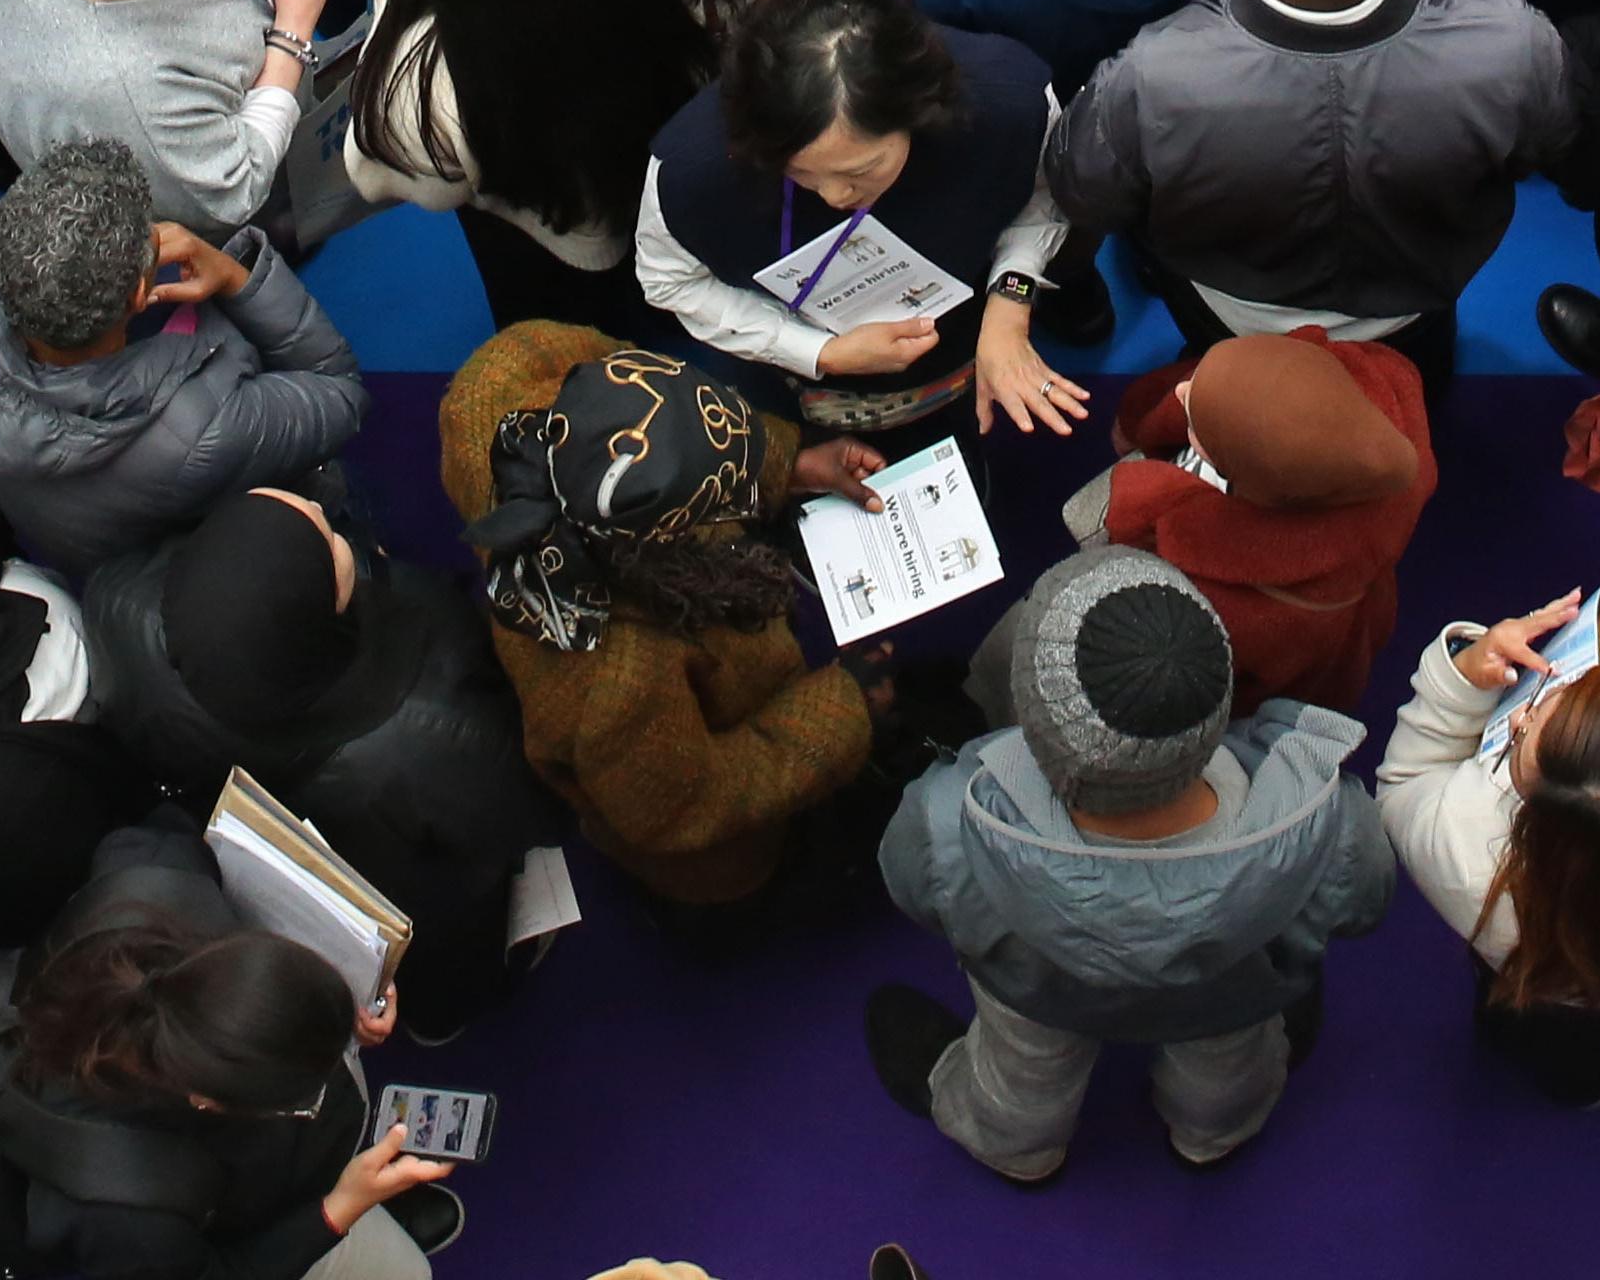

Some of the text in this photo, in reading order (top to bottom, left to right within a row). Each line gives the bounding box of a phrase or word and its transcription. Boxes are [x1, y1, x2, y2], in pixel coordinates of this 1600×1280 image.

[815, 257, 912, 312] We are hiring
[884, 494, 927, 599] We are hiring
